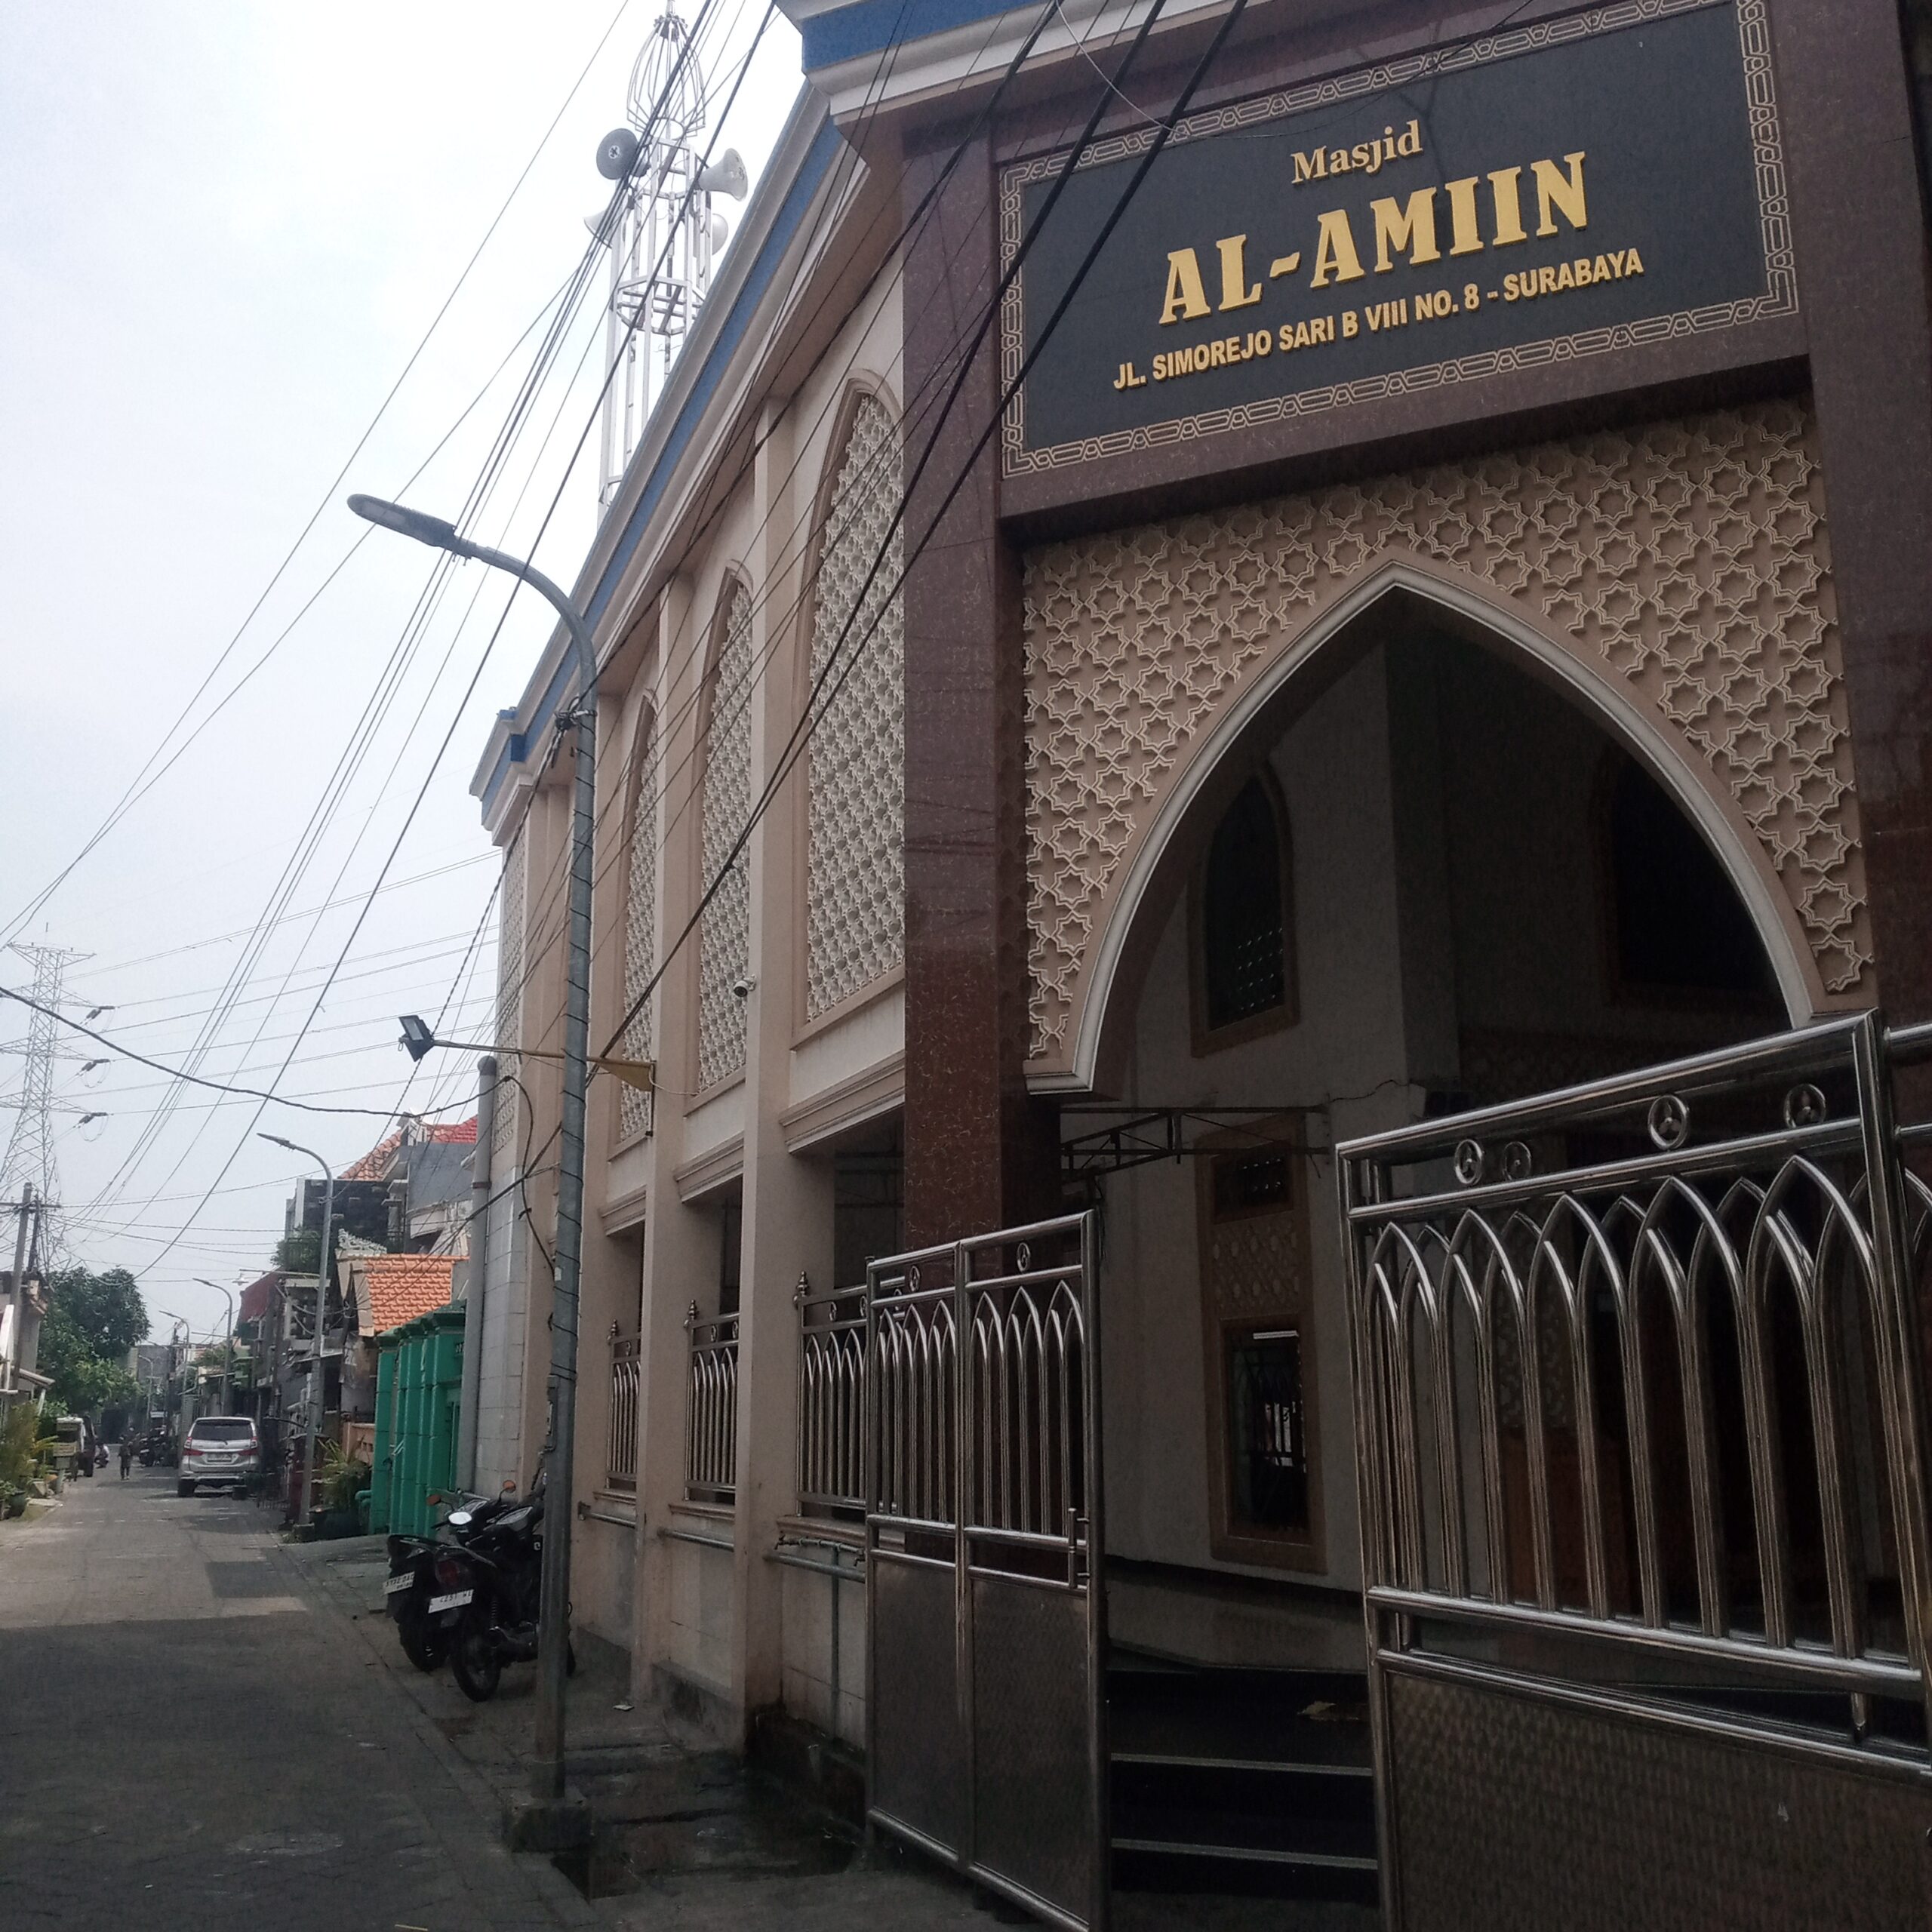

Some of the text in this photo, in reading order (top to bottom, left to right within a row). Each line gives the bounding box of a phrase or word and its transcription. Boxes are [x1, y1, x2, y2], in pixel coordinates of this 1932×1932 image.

[1291, 119, 1423, 183] Masjid
[1158, 152, 1588, 325] AL-AMIIN
[1113, 248, 1644, 389] JL. SIMOREJO SARI B VIII NO. 8 - SURABAYA
